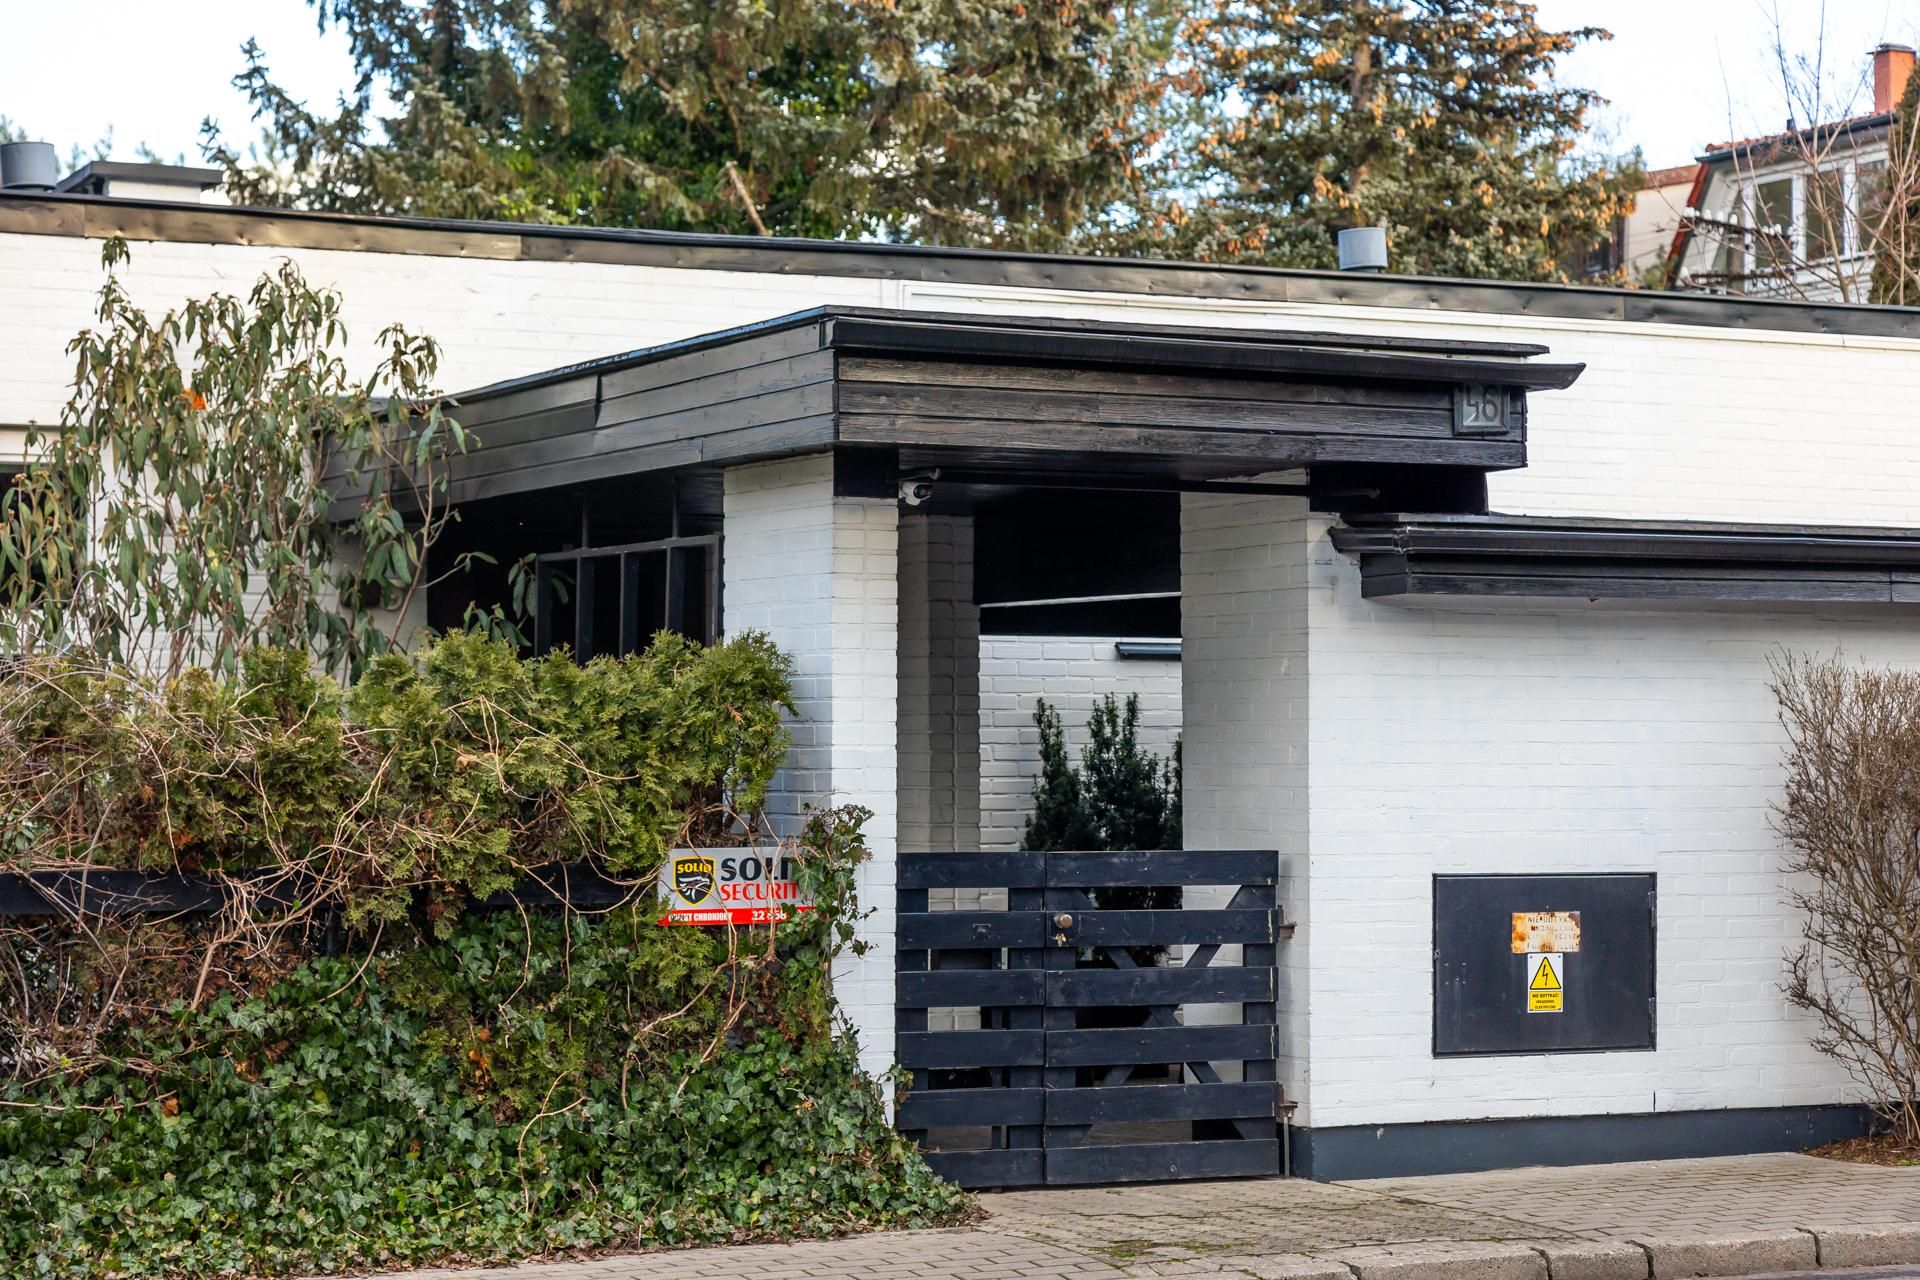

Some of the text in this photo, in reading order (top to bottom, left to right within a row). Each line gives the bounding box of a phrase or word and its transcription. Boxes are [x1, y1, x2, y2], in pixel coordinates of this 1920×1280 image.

[1465, 382, 1499, 423] 46
[677, 862, 712, 874] SOLID
[720, 857, 791, 882] SOLI
[720, 881, 800, 901] SECURIT
